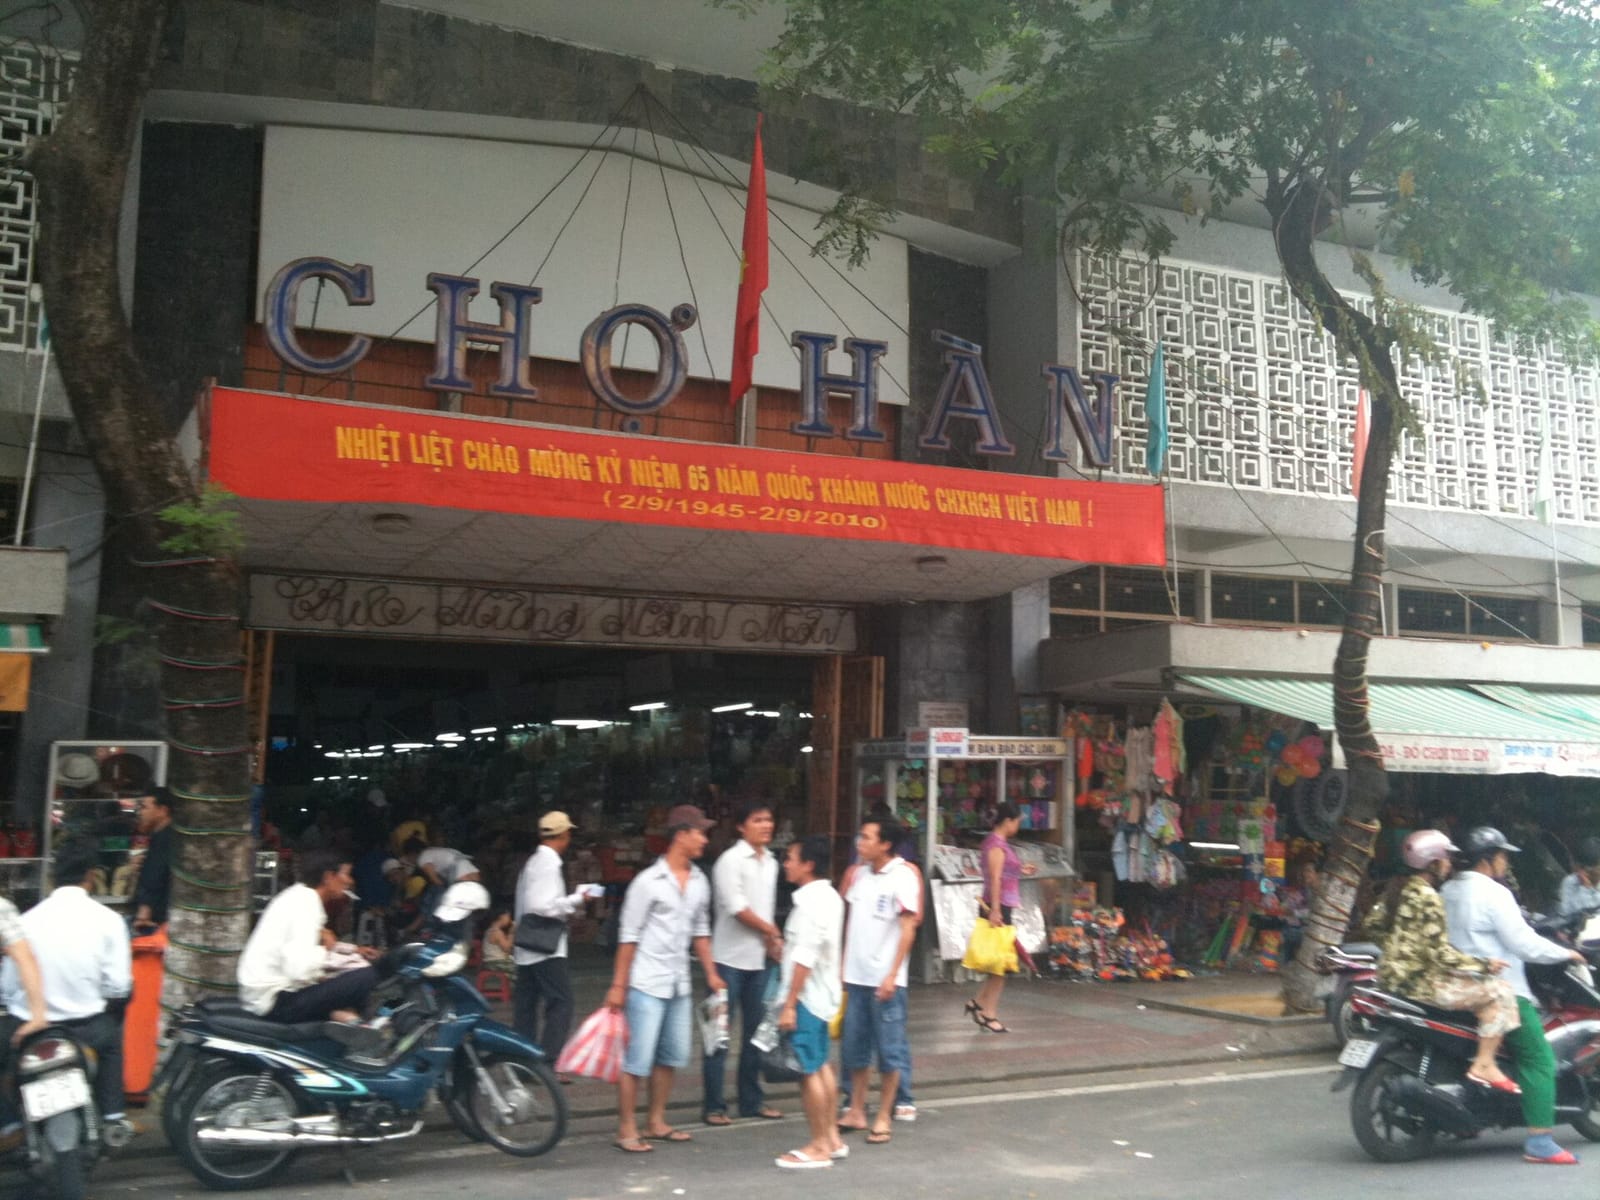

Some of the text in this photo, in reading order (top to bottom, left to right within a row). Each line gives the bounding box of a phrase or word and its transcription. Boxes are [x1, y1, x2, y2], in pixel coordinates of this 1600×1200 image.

[264, 254, 1120, 468] CHỢ HÀN
[335, 423, 401, 468] NHIỆT
[408, 430, 453, 473] LIỆT
[462, 437, 520, 475] CHÀO
[527, 444, 593, 482] MỪNG
[595, 448, 623, 485] KỶ
[628, 455, 682, 494] NIỆM
[687, 464, 710, 492] 65
[715, 463, 761, 498] NĂM
[765, 464, 815, 502] QUỐC
[819, 474, 881, 507] KHÁNH
[882, 479, 931, 511] NƯỚC
[934, 487, 1003, 520] CHXHCN
[1004, 490, 1040, 527] VIỆT
[1044, 497, 1083, 528] NAM
